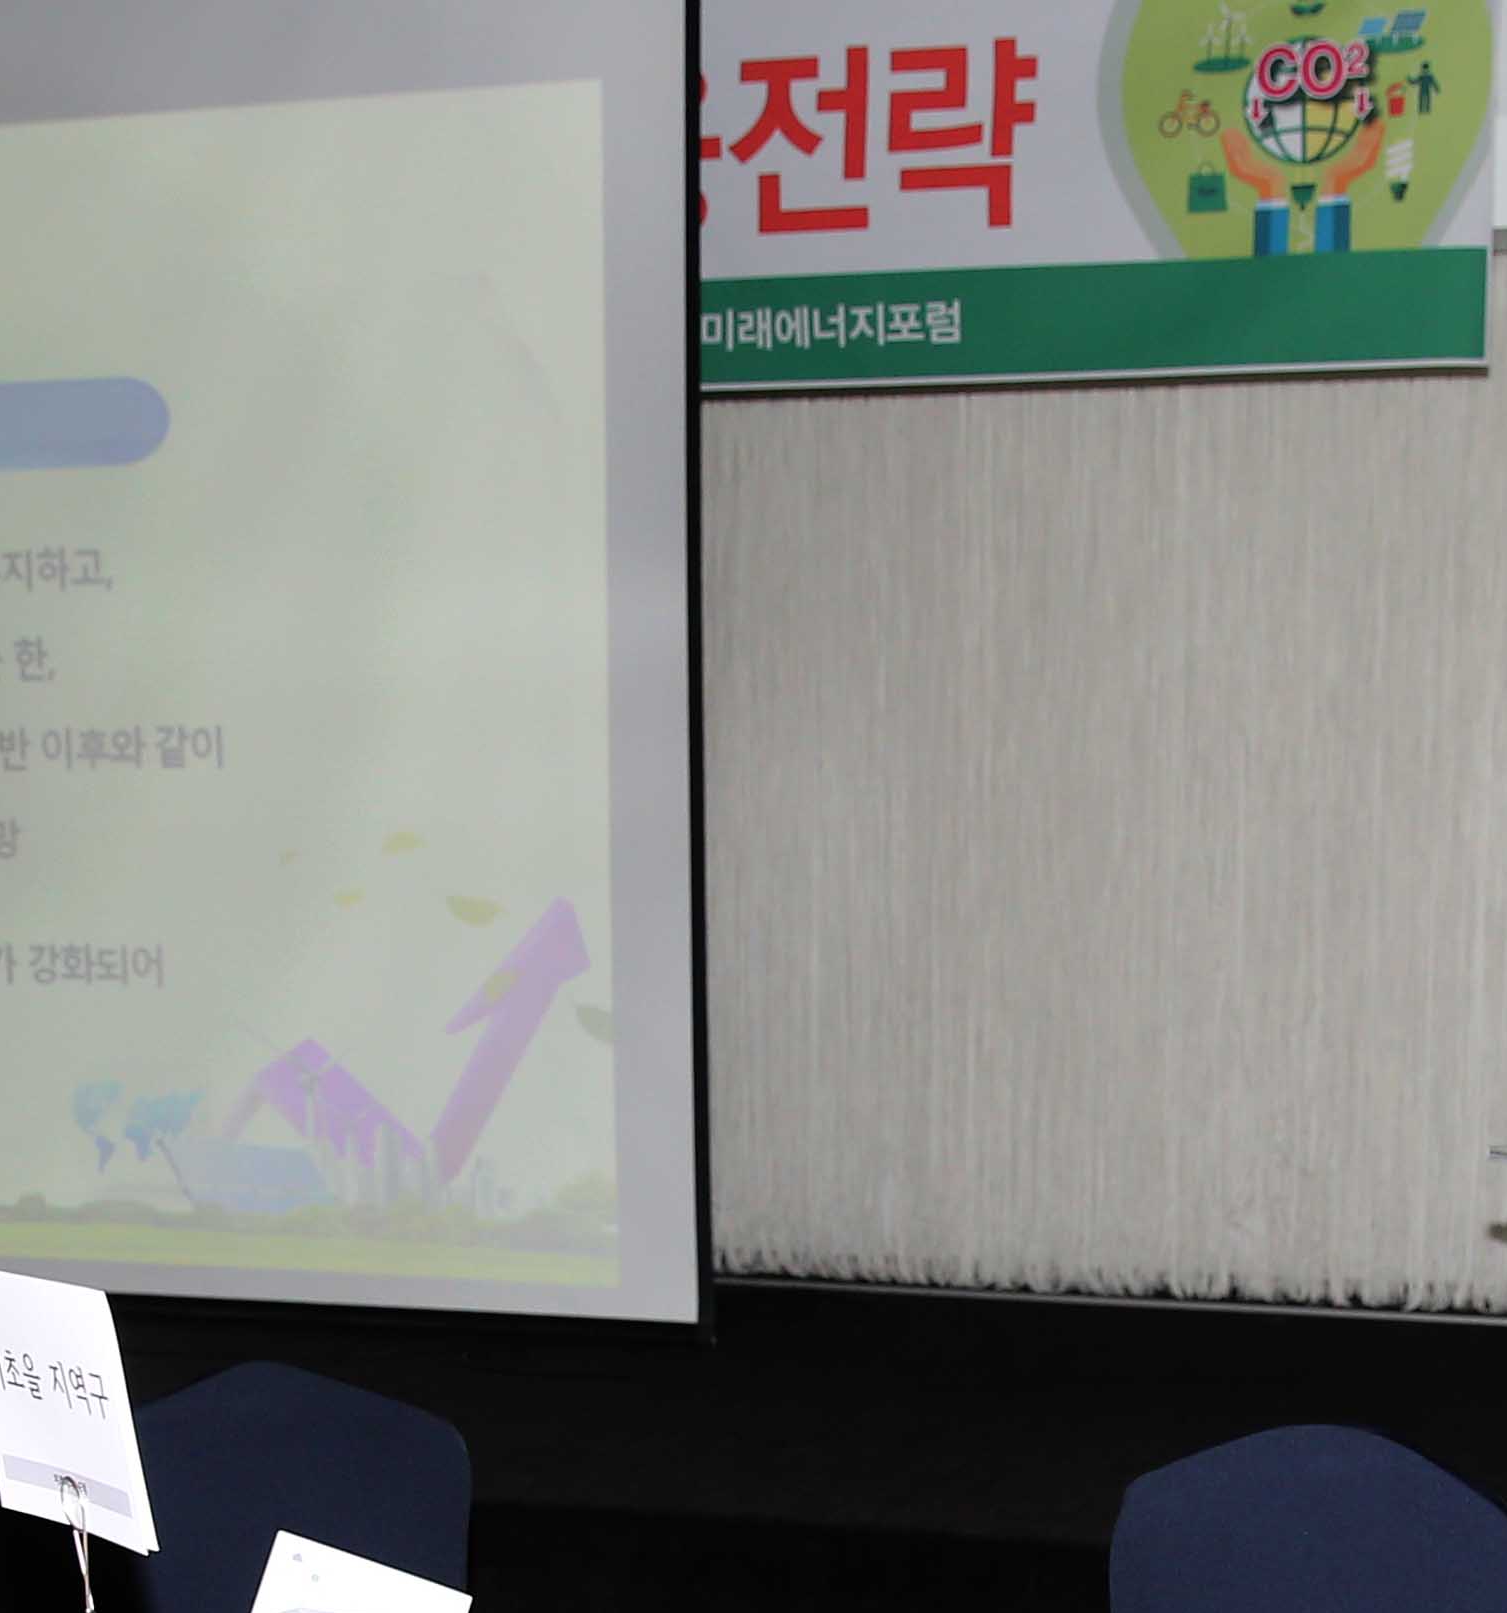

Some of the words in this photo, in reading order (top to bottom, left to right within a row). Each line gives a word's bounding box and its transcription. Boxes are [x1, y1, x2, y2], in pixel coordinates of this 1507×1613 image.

[699, 37, 1037, 236] 전략
[700, 298, 963, 352] 미래에너지포럼
[13, 635, 57, 683] 한,
[41, 724, 146, 770] 이후와
[153, 724, 225, 769] 같이
[28, 942, 165, 989] 강화되어
[48, 1360, 109, 1421] 지역구
